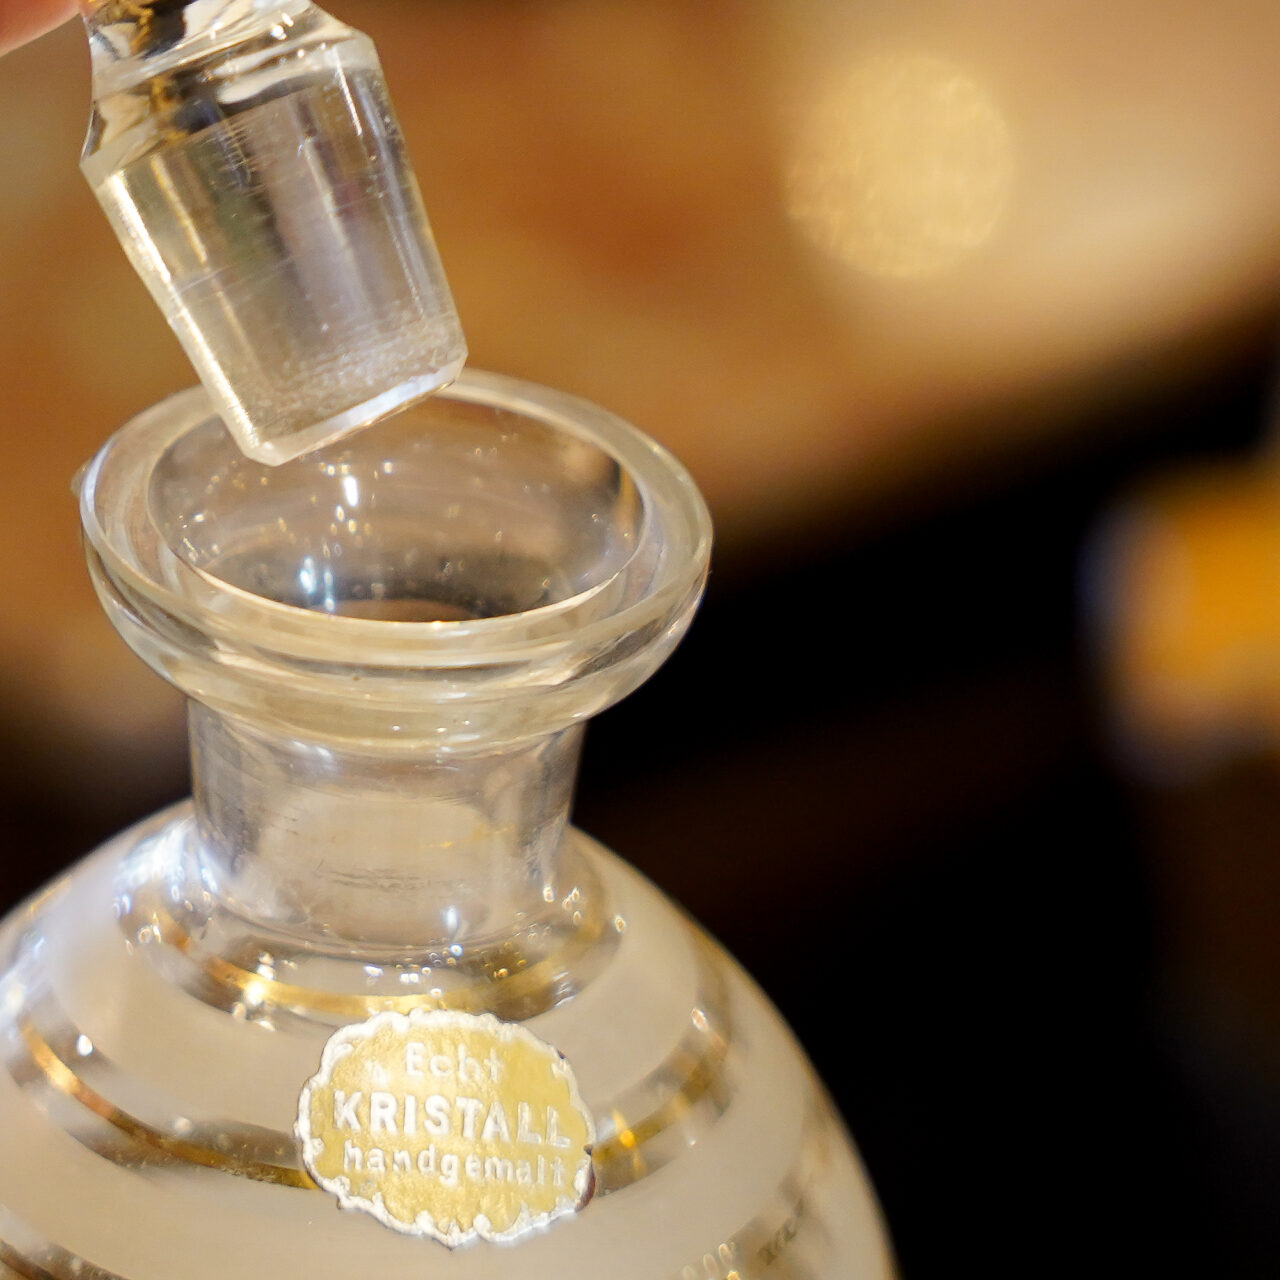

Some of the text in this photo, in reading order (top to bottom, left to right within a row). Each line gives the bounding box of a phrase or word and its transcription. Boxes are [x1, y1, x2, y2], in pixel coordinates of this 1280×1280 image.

[405, 1041, 504, 1082] Echt
[333, 1090, 570, 1148] KRISTALL
[344, 1139, 565, 1186] handgemalt
